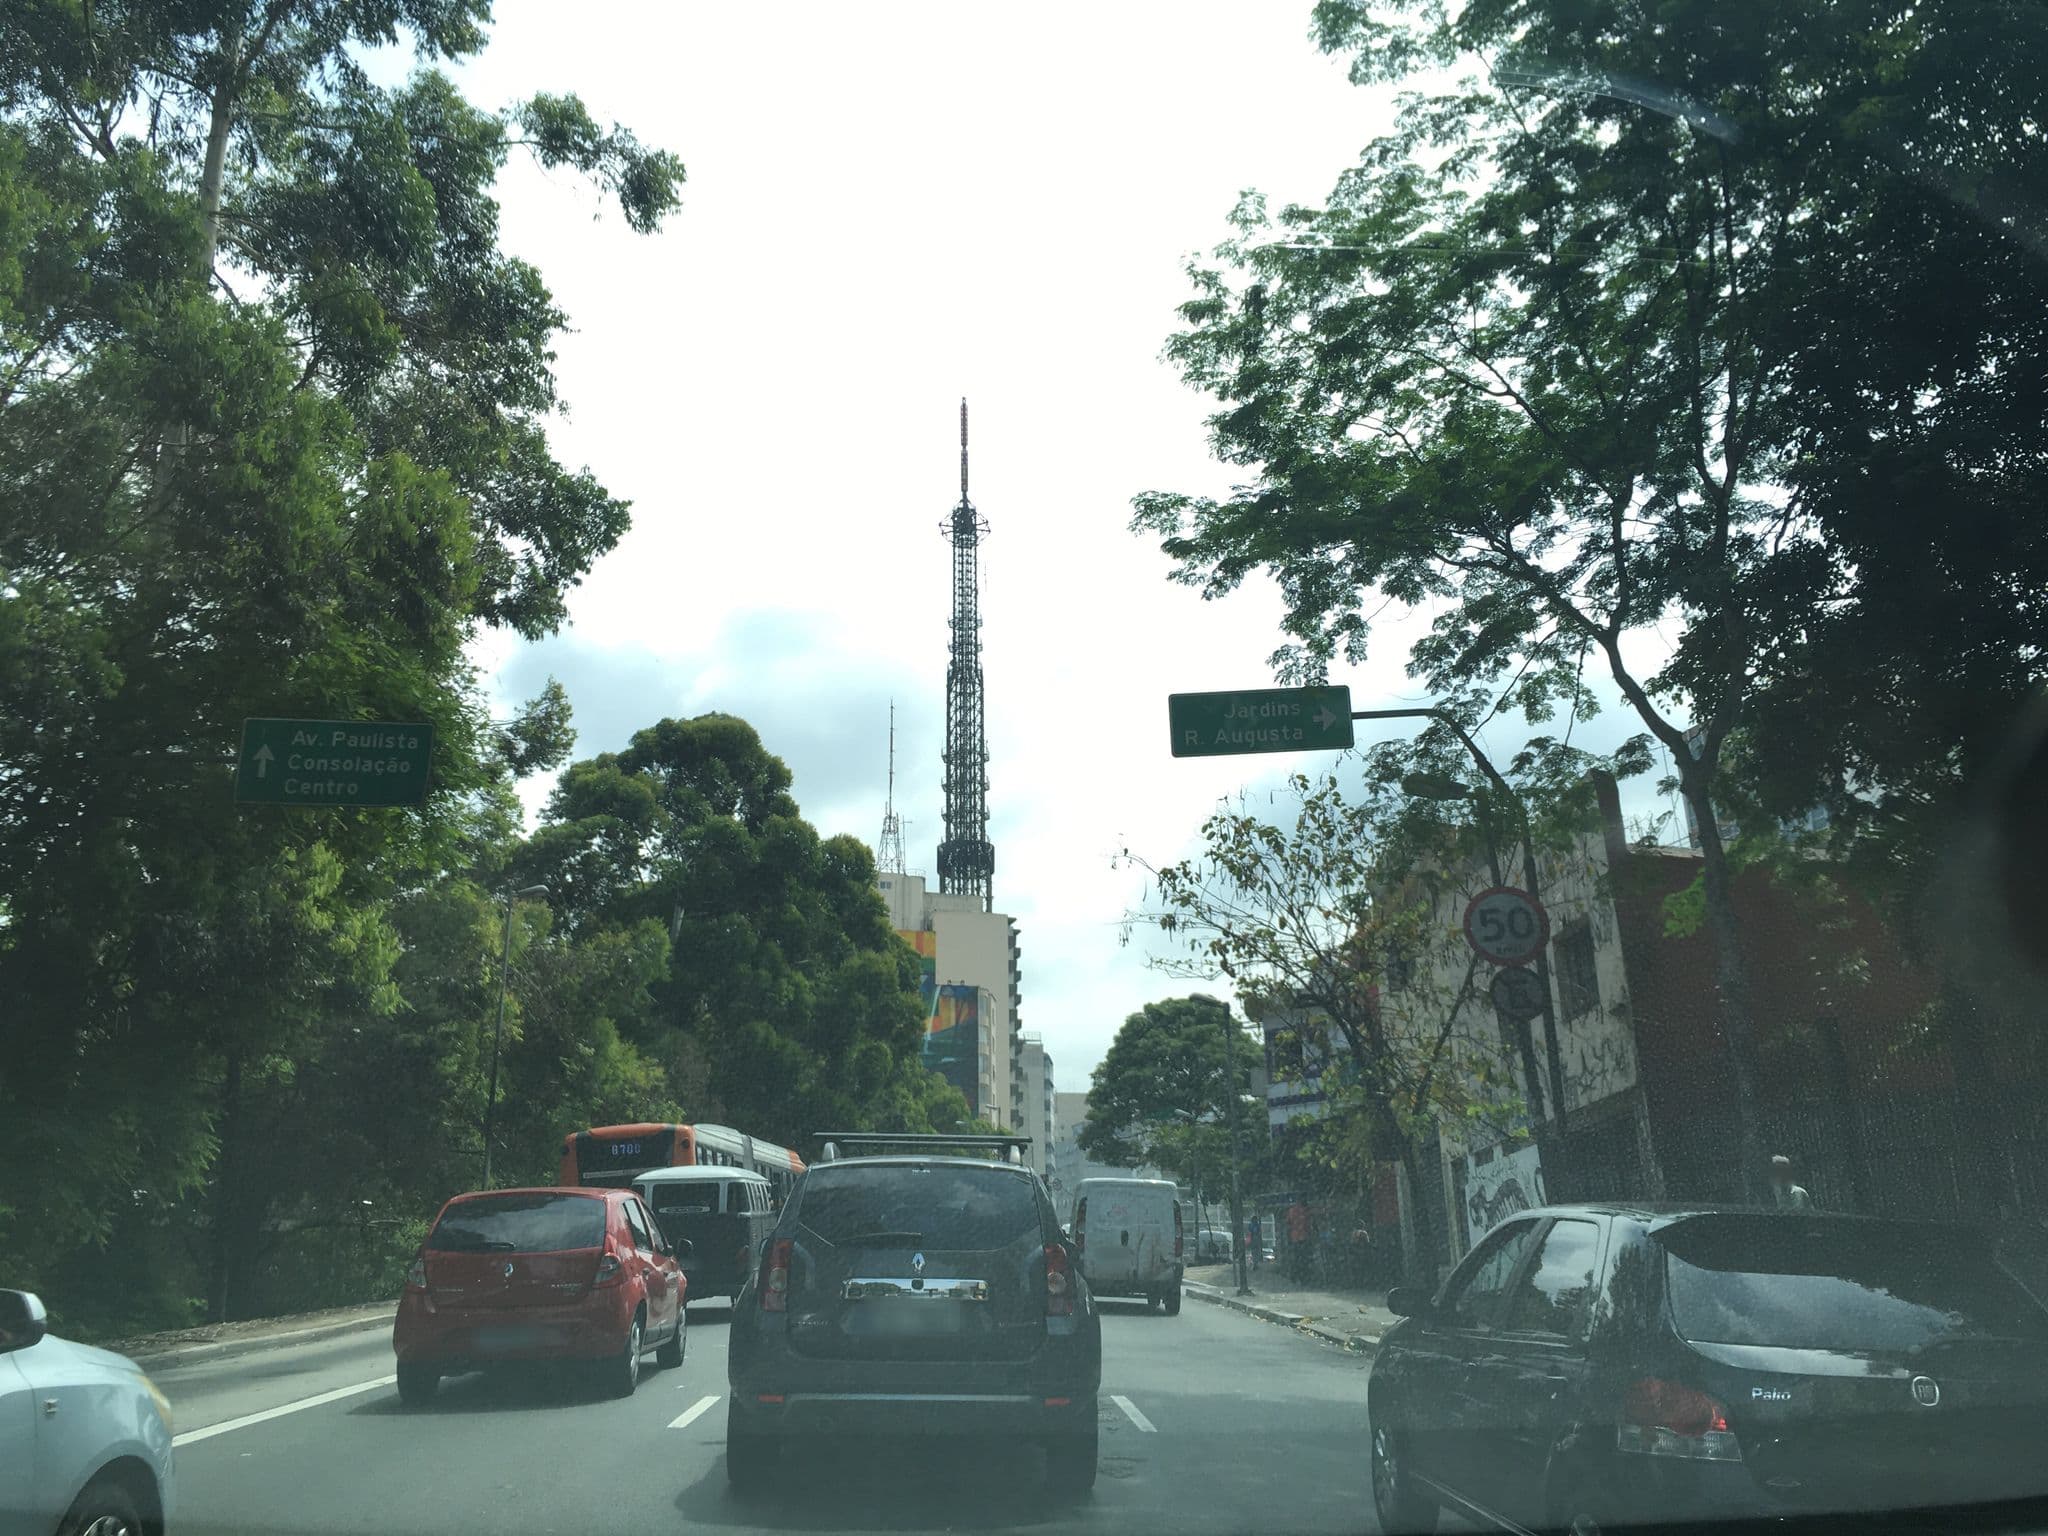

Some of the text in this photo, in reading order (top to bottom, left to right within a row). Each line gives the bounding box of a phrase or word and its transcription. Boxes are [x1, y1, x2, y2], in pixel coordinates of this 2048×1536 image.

[1223, 702, 1301, 719] Jardins
[291, 730, 419, 750] Av. Paulista
[1184, 726, 1303, 747] R. Augusta
[287, 754, 411, 775] Consolação
[284, 778, 359, 795] Centro
[1479, 906, 1535, 942] 50
[1751, 1386, 1792, 1400] Palio
